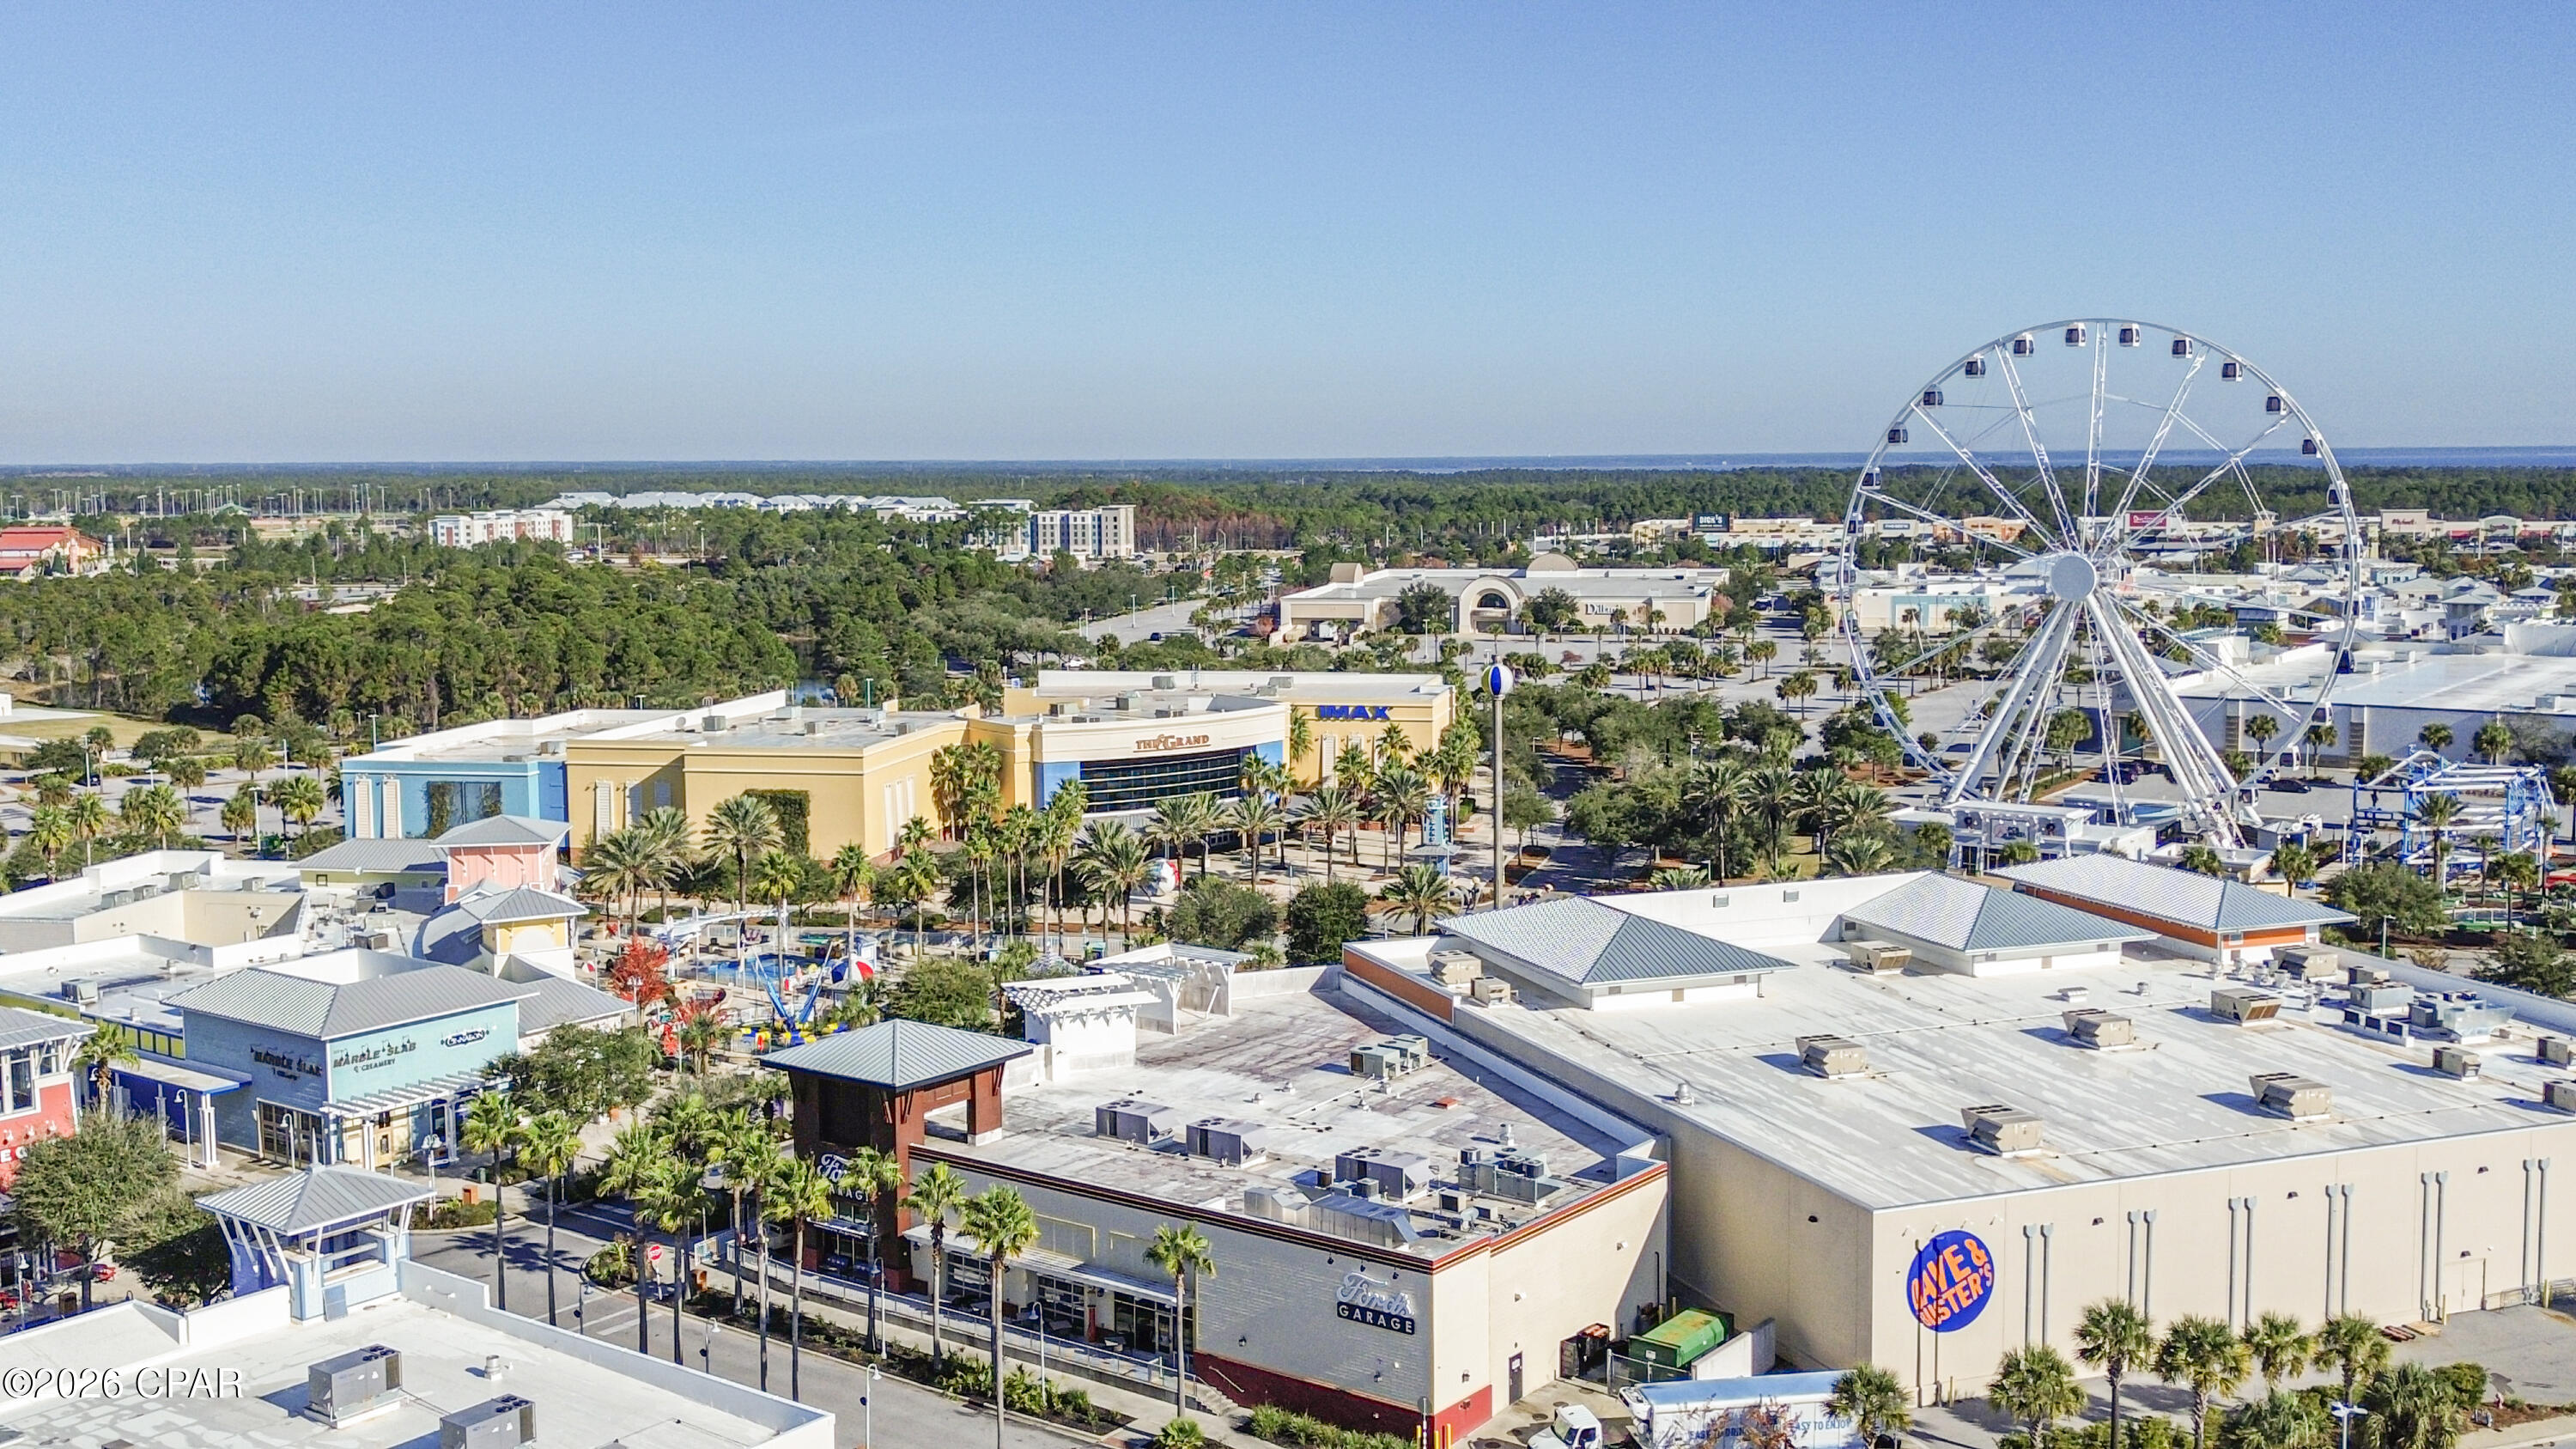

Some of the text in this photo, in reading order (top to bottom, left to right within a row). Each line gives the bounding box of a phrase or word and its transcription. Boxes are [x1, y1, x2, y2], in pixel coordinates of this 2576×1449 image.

[1316, 704, 1391, 721] IMAX
[1163, 734, 1210, 750] GRAND
[333, 1050, 381, 1068] MARBLE
[1911, 1239, 1988, 1311] DAVE &
[1336, 1272, 1415, 1319] Ford's
[1919, 1263, 1993, 1327] BUSTER'S
[1339, 1305, 1413, 1333] GARAGE
[1814, 1420, 1824, 1430] TO
